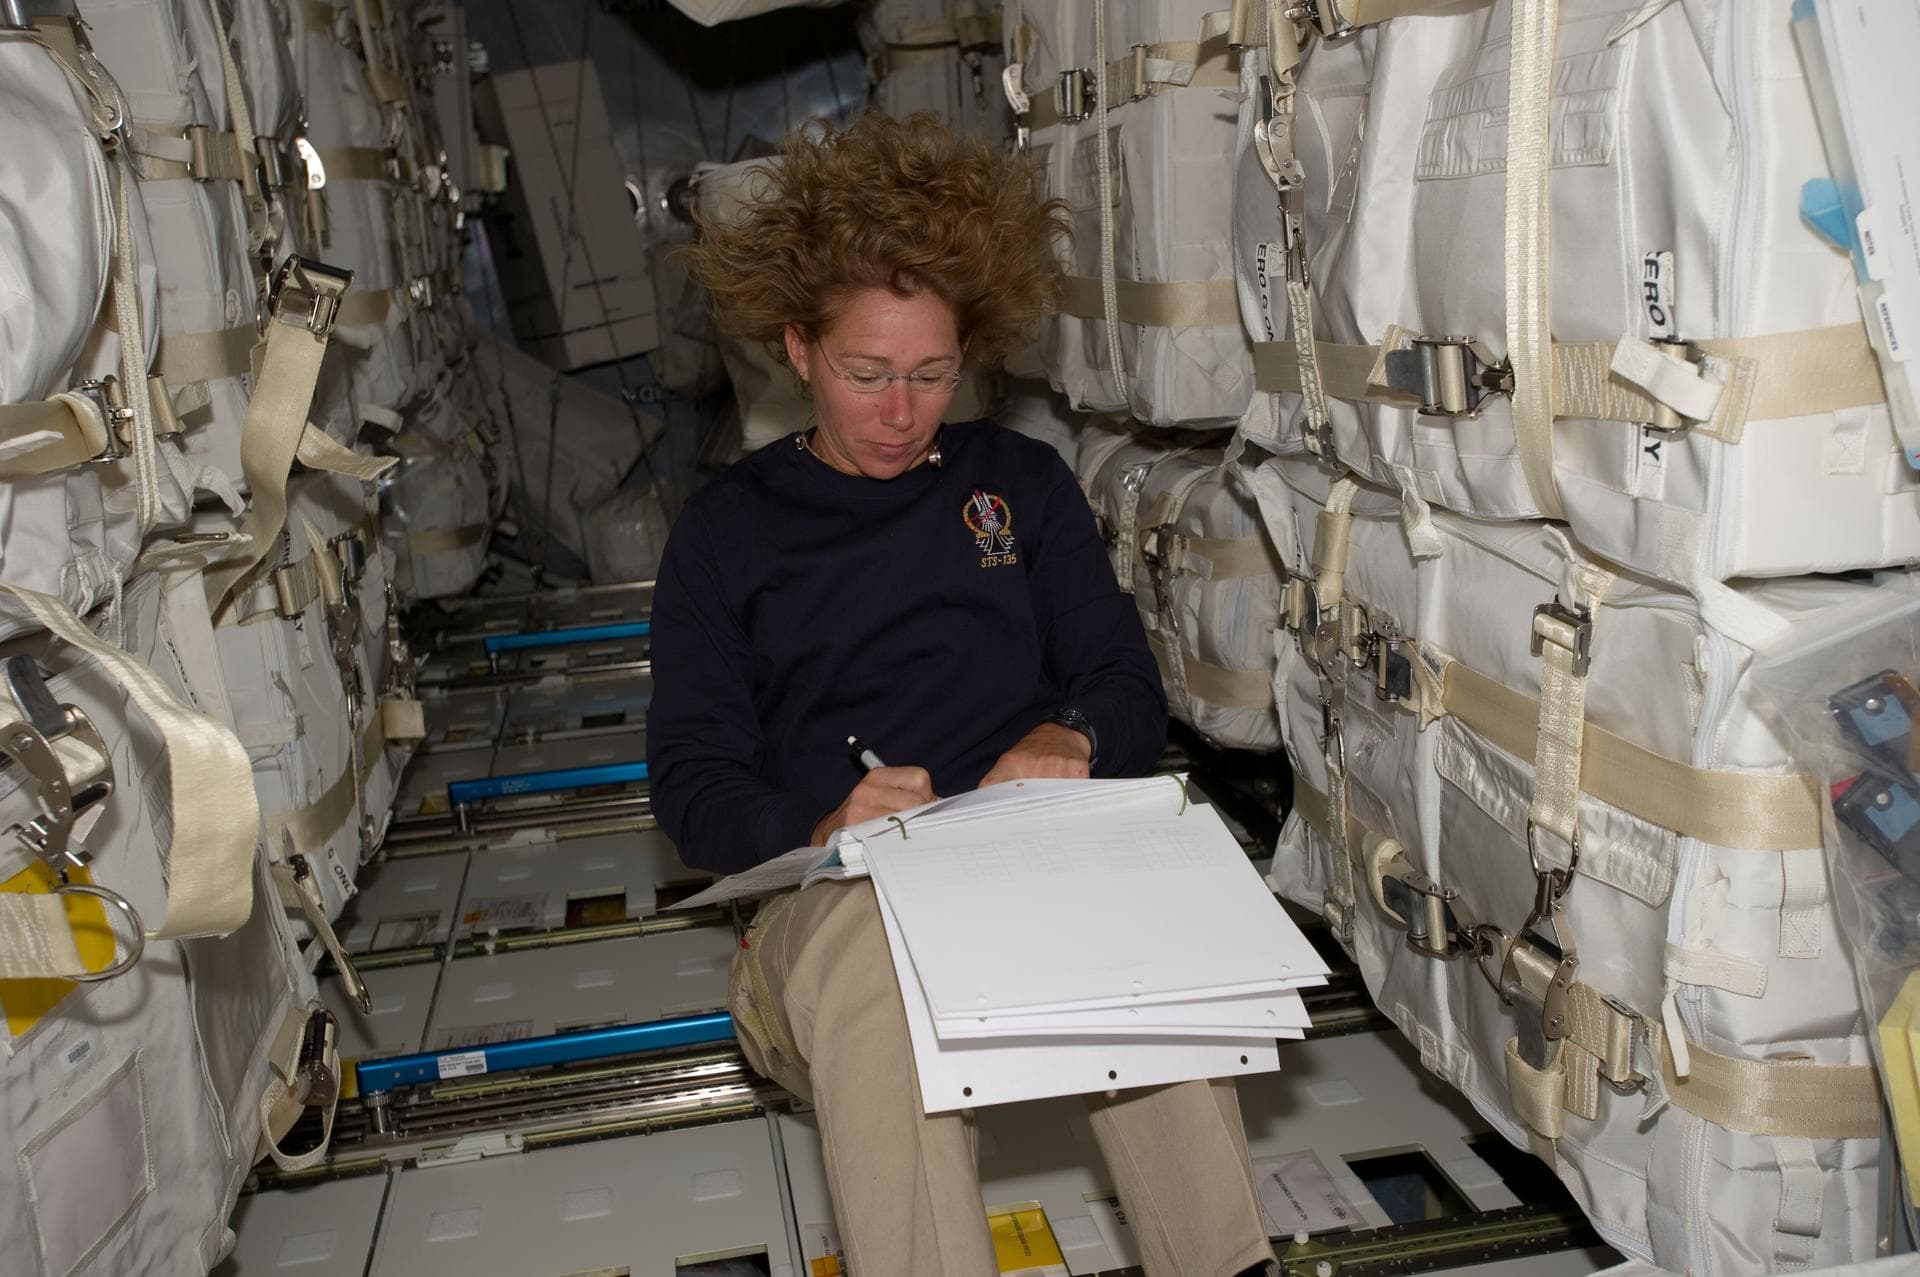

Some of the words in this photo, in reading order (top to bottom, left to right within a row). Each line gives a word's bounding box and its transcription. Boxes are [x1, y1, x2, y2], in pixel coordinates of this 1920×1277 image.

[1864, 230, 1875, 256] NOTES
[1643, 251, 1667, 326] ERO
[1880, 302, 1899, 352] REFERENCES
[980, 554, 1017, 568] STS-135
